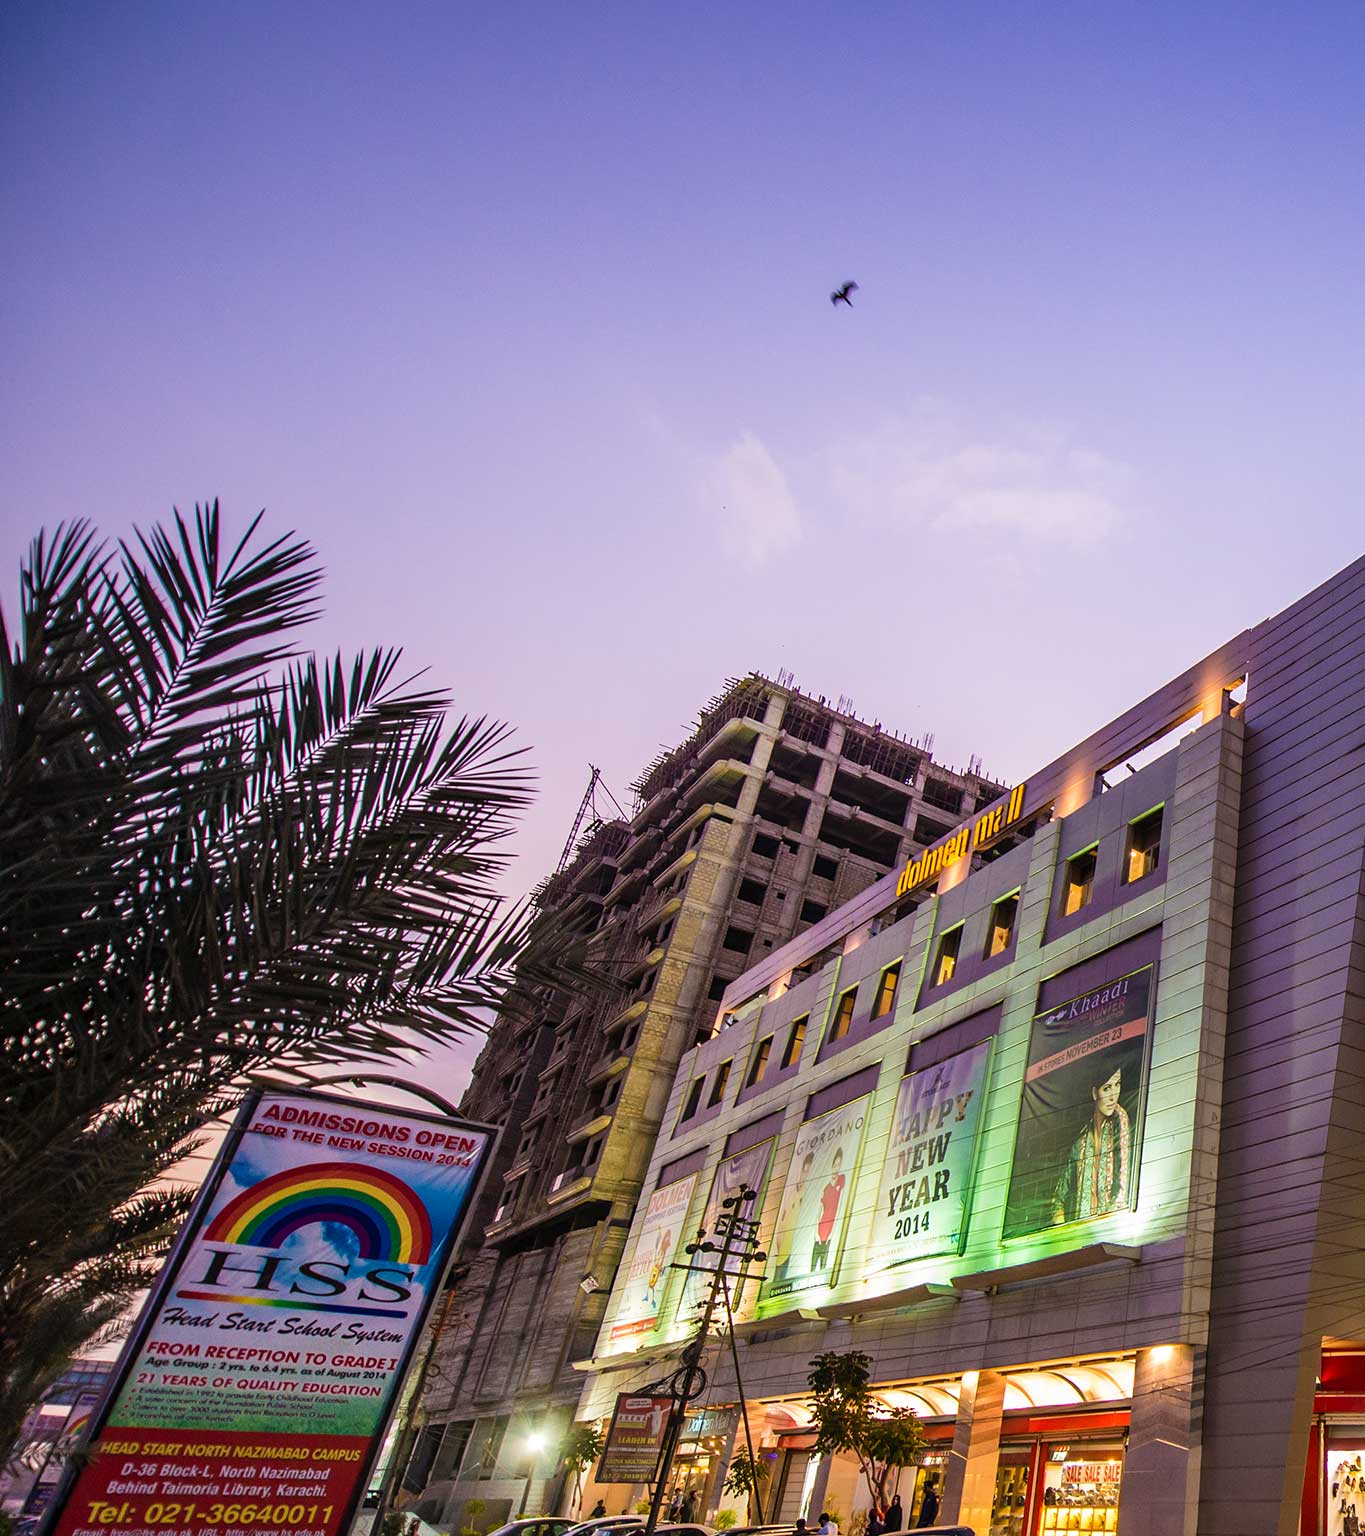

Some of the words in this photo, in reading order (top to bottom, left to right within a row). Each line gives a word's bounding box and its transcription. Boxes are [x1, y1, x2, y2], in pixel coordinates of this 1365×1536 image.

[896, 828, 969, 897] dolmen
[973, 783, 1026, 849] mall
[1068, 981, 1129, 1019] Khaadi
[1066, 1033, 1110, 1059] NOVEMBER
[1111, 1028, 1122, 1041] 23
[262, 1104, 411, 1142] ADMISSIONS
[415, 1130, 477, 1152] OPEN
[796, 1117, 864, 1156] GIORDANO
[252, 1123, 288, 1138] FOR
[292, 1129, 325, 1145] THE
[327, 1136, 365, 1152] NEW
[367, 1142, 434, 1162] SESSION
[435, 1153, 472, 1168] 2014
[895, 1131, 952, 1180] NEW
[888, 1169, 951, 1217] YEAR
[894, 1211, 930, 1240] 2014
[190, 1249, 416, 1303] HSS
[162, 1307, 214, 1328] Head
[219, 1312, 273, 1333] Start
[277, 1318, 342, 1339] School
[341, 1323, 403, 1345] System
[145, 1357, 169, 1368] Age
[173, 1358, 209, 1370] Group
[228, 1363, 246, 1372] yrs.
[249, 1364, 260, 1372] to
[262, 1364, 278, 1373] 6.4
[280, 1366, 298, 1375] yrs.
[300, 1368, 312, 1376] as
[314, 1367, 326, 1376] of
[326, 1368, 361, 1379] August
[362, 1371, 386, 1380] 2014
[146, 1341, 200, 1357] FROM
[204, 1345, 300, 1364] RECEPTION
[304, 1353, 327, 1366] TO
[331, 1355, 387, 1369] GRADE
[137, 1373, 155, 1383] 21
[162, 1374, 208, 1387] YEARS
[212, 1377, 233, 1388] OF
[236, 1379, 299, 1391] QUALITY
[301, 1382, 382, 1396] EDUCATION
[100, 1442, 139, 1455] HEAD
[141, 1443, 182, 1456] START
[183, 1444, 231, 1457] NORTH
[232, 1446, 310, 1459] NAZIMABAD
[312, 1448, 361, 1461] CAMPUS
[121, 1462, 157, 1476] D-36
[160, 1463, 214, 1480] Block-L,
[219, 1465, 256, 1478] North
[260, 1466, 331, 1480] Nazimabad
[1066, 1465, 1082, 1482] SALE
[1085, 1465, 1100, 1482] SALE
[1103, 1465, 1120, 1482] SALE
[106, 1481, 158, 1495] Behind
[161, 1482, 219, 1495] Taimoria
[222, 1483, 272, 1499] Library,
[276, 1483, 328, 1497] Karachi.
[87, 1502, 136, 1524] Tel:
[144, 1503, 334, 1525] 021-36640011
